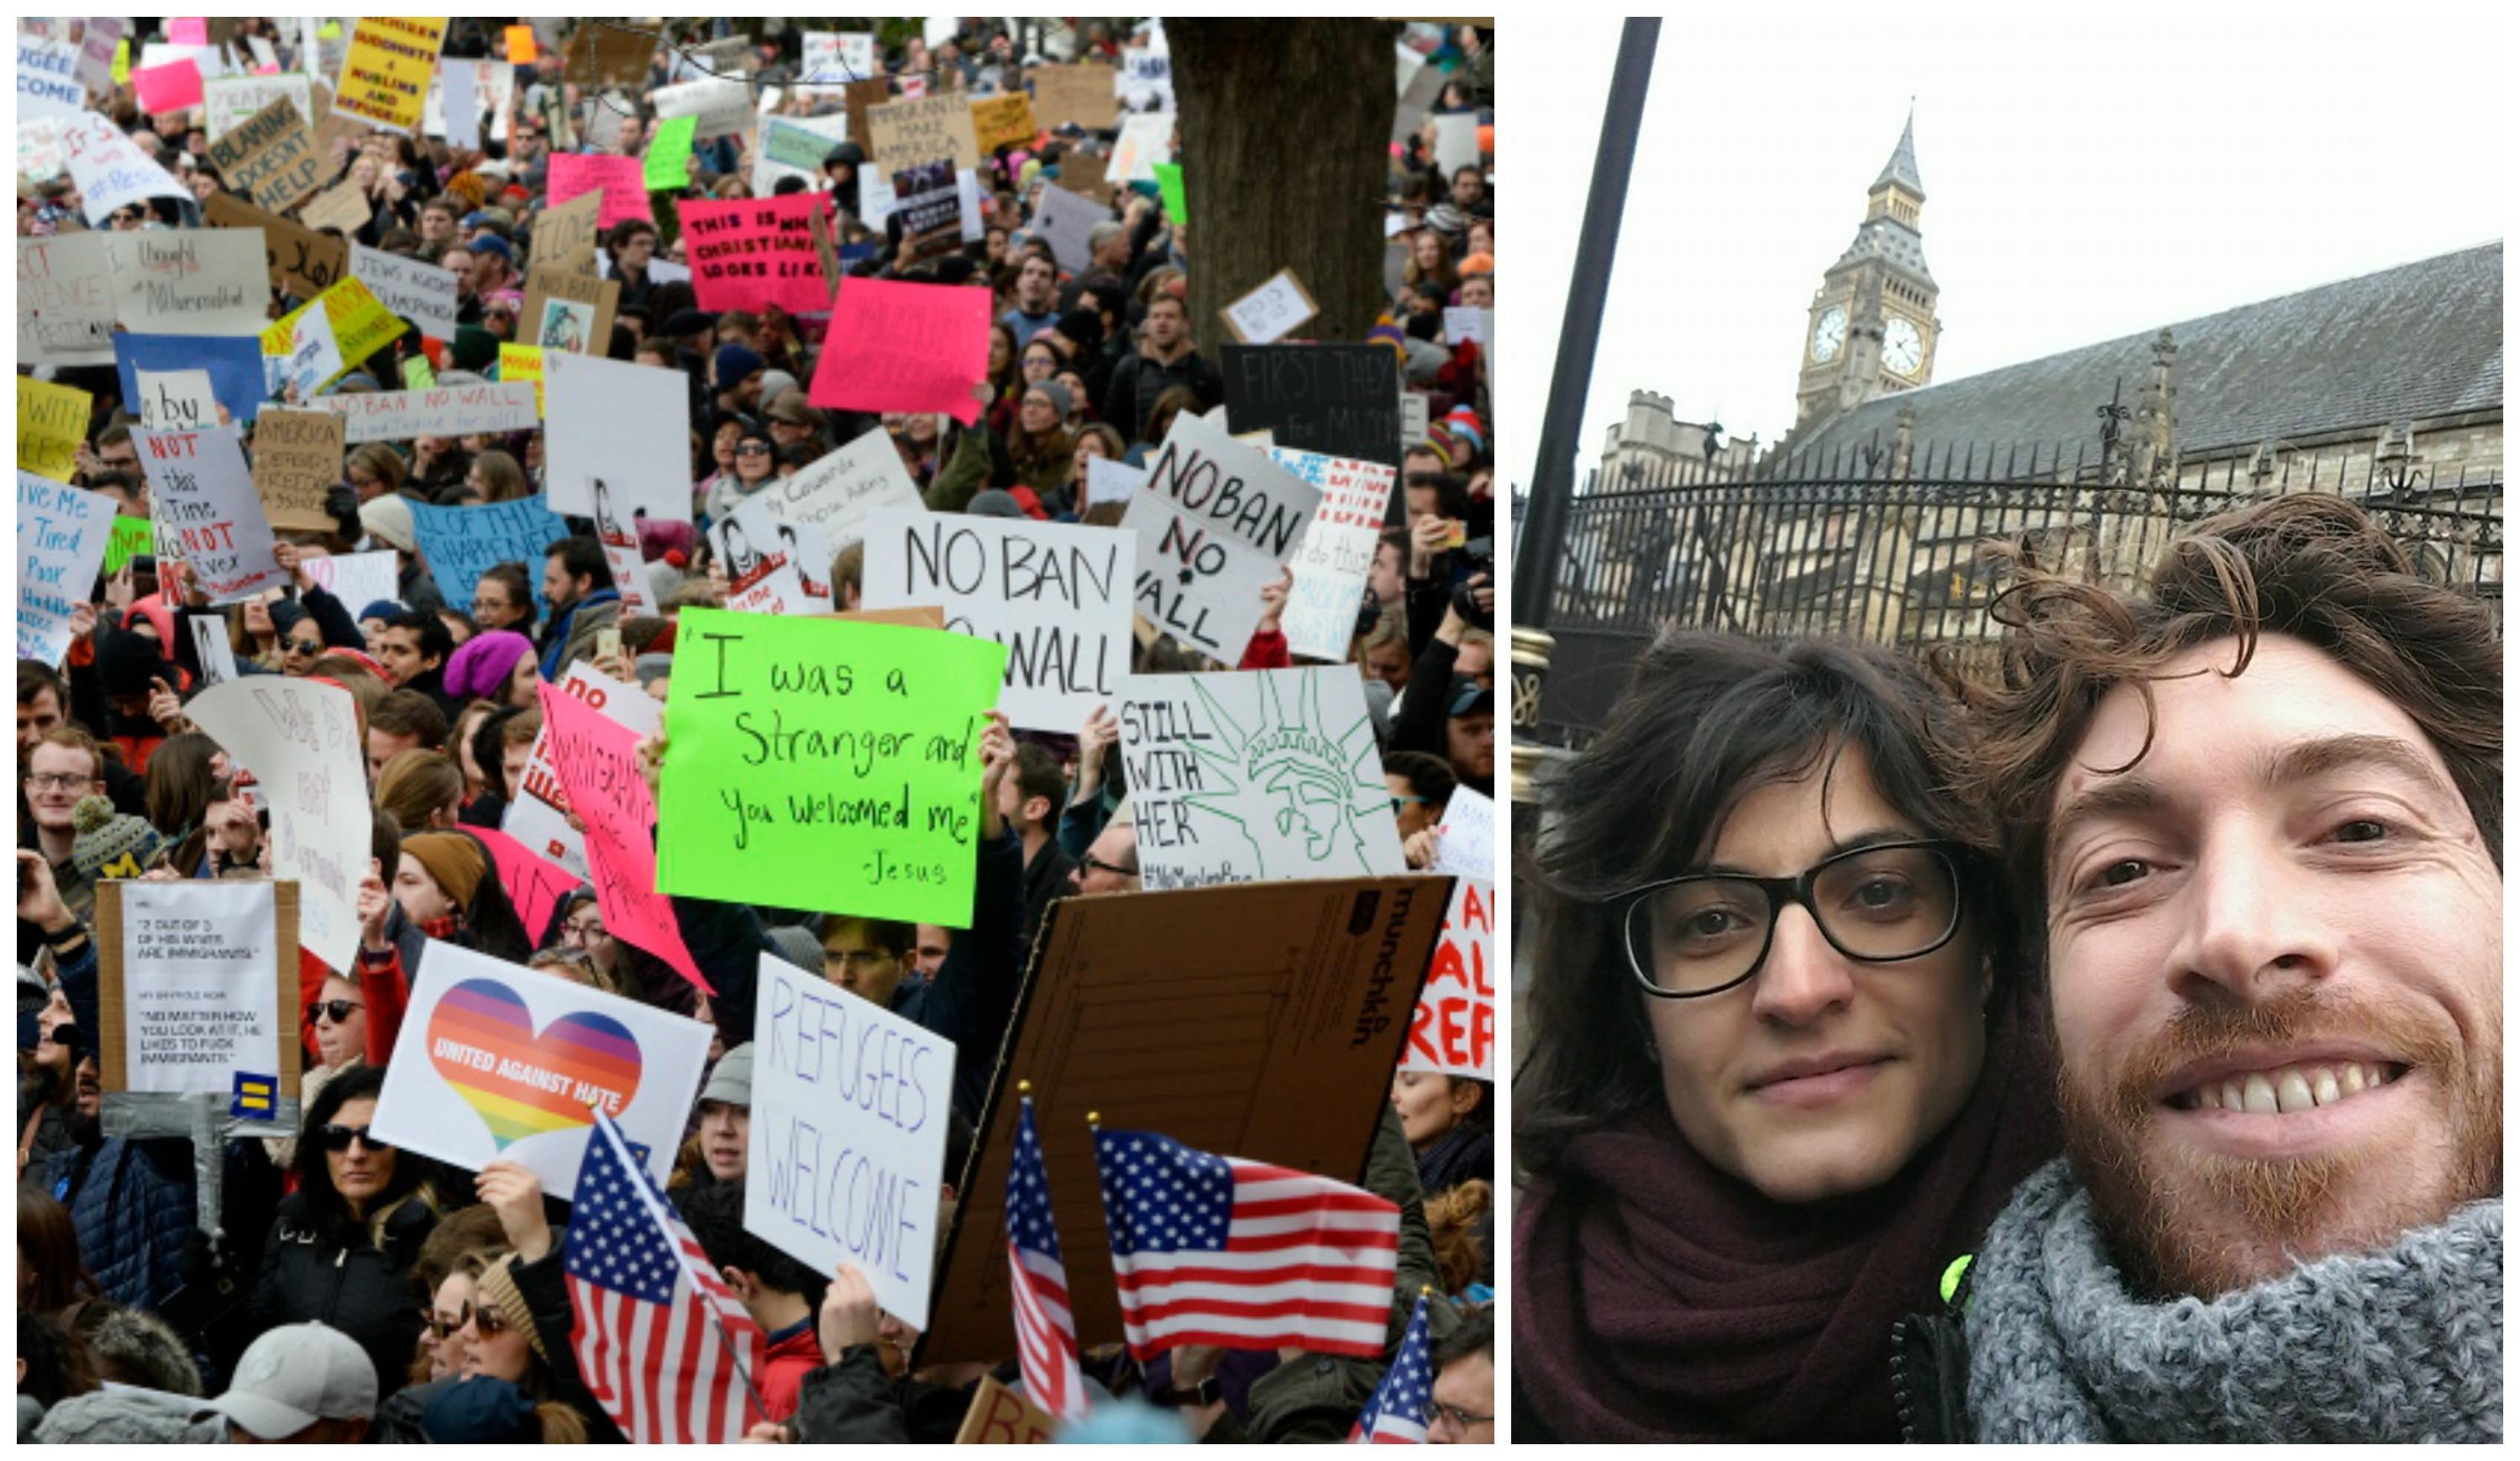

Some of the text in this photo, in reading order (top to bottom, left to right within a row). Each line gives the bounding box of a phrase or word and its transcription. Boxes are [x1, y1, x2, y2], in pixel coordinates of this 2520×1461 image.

[212, 99, 297, 167] BLAMING
[877, 135, 960, 158] AMERICA
[897, 120, 944, 141] MAKE
[255, 157, 317, 208] HELP
[690, 213, 741, 236] THIS
[755, 211, 775, 228] IS
[356, 255, 402, 281] JEWS
[701, 262, 767, 279] LOOKS
[1242, 349, 1391, 407] FIRST THEY
[159, 383, 198, 423] by
[365, 397, 410, 416] BAN
[425, 390, 451, 409] NO
[458, 387, 525, 407] WALL
[146, 433, 199, 460] NOT
[259, 419, 338, 446] AMERICA
[161, 467, 199, 493] this
[1147, 440, 1220, 511] NO
[1209, 475, 1302, 558] BAN
[181, 518, 235, 553] NOT
[445, 509, 473, 536] OF
[1158, 513, 1226, 575] NO
[906, 520, 1116, 611] NO BAN
[1135, 570, 1221, 649] ALL
[995, 625, 1114, 696] WALL
[565, 675, 607, 710] no
[769, 662, 854, 697] was
[885, 667, 908, 697] a
[1121, 699, 1213, 746] STILL
[734, 709, 974, 779] Stranger and
[1126, 750, 1204, 791] WITH
[1132, 800, 1200, 847] HER
[137, 946, 164, 959] ARE
[1351, 887, 1415, 1047] munchkin
[139, 1025, 168, 1036] YOU
[171, 1024, 205, 1036] LOOK
[208, 1024, 225, 1036] AT
[167, 1011, 221, 1022] MATTER
[223, 1011, 257, 1022] HOW
[140, 1038, 234, 1050] LIKES TO FUCK
[767, 976, 932, 1134] REFUGEES
[433, 1038, 622, 1113] UNITED AGAINST HATE
[762, 1105, 920, 1283] WELCOME
